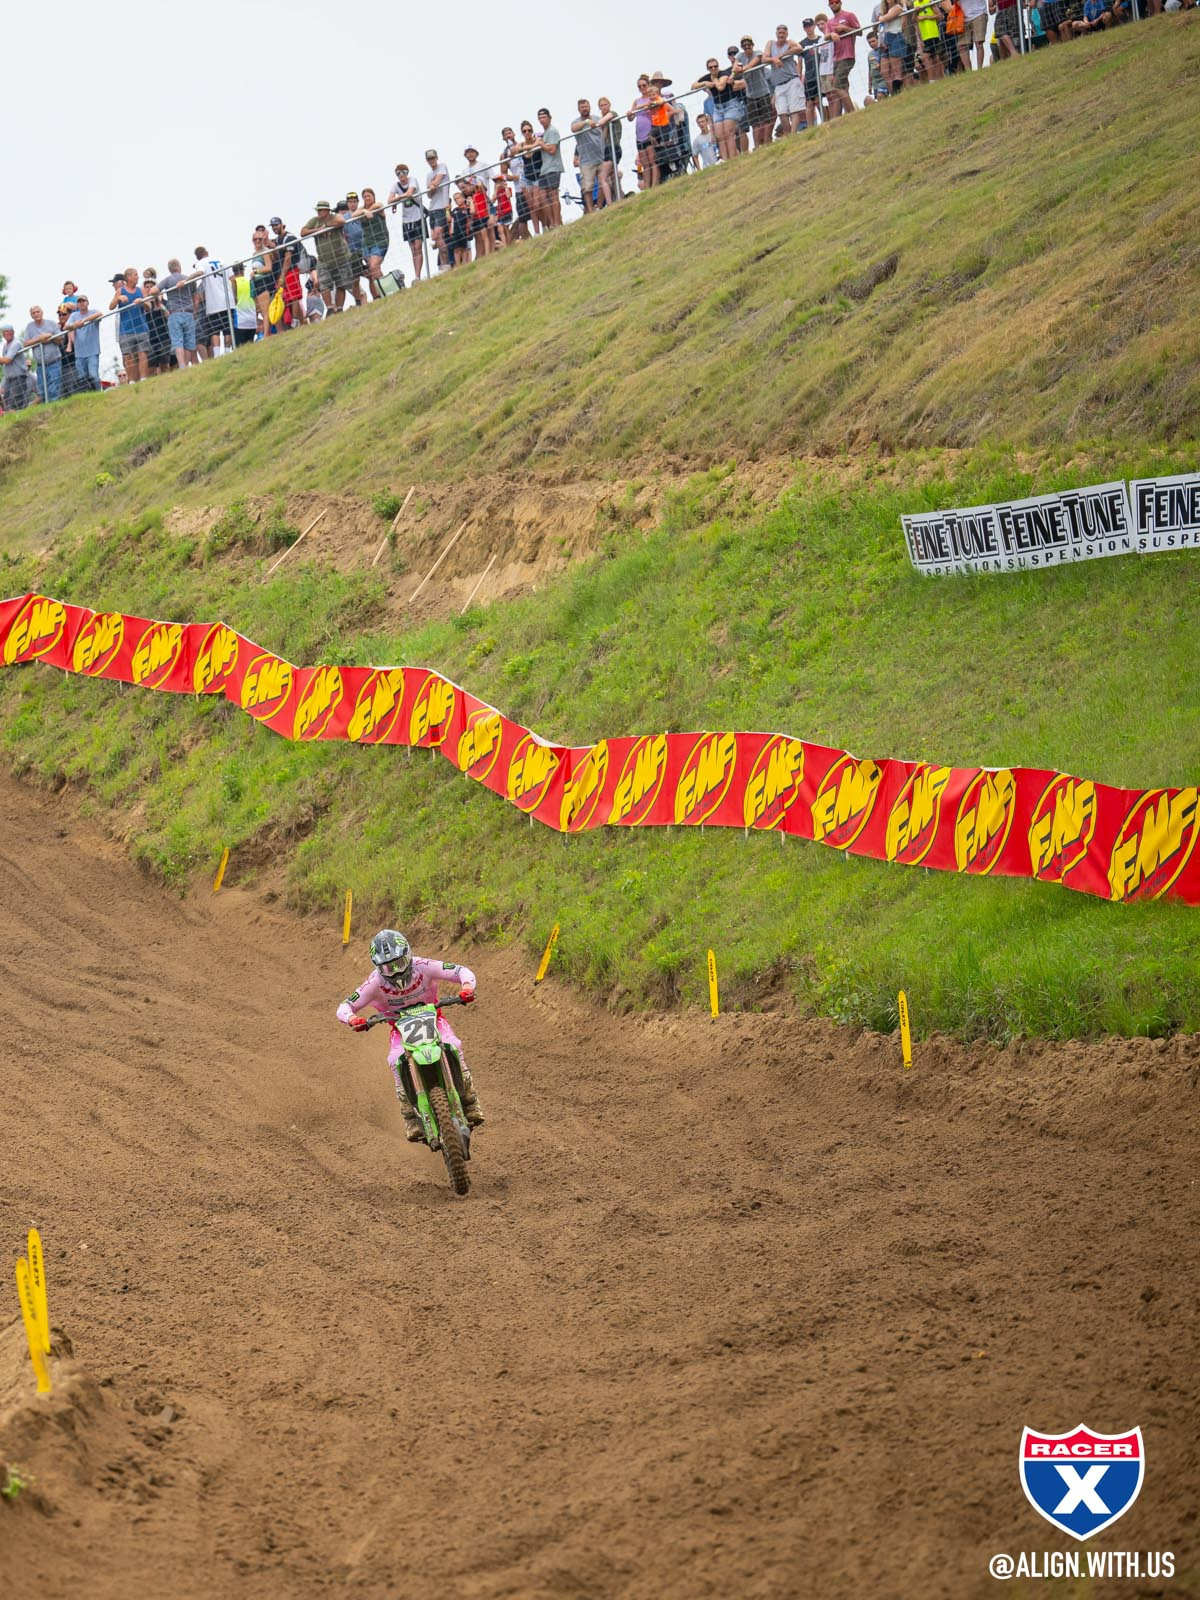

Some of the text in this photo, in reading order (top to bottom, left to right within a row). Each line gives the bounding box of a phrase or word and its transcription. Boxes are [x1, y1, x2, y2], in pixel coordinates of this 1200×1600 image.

[1008, 538, 1130, 569] SUSPENSION
[75, 613, 122, 672] FMF
[133, 625, 182, 683] FMF
[195, 627, 237, 693] FMF
[242, 659, 292, 709] FMF
[294, 667, 340, 741] FMF
[349, 668, 403, 742] FMF
[411, 680, 453, 745] FMF
[459, 714, 501, 771] FMF
[508, 744, 556, 800] FMF
[609, 735, 665, 824] FMF
[676, 733, 734, 824] FMF
[745, 738, 801, 828] FMF
[814, 760, 878, 841] FMF
[887, 767, 951, 861] FMF
[957, 771, 1013, 872] FMF
[1031, 780, 1094, 878] FMF
[1111, 788, 1197, 901] FMF
[404, 1018, 435, 1044] 21
